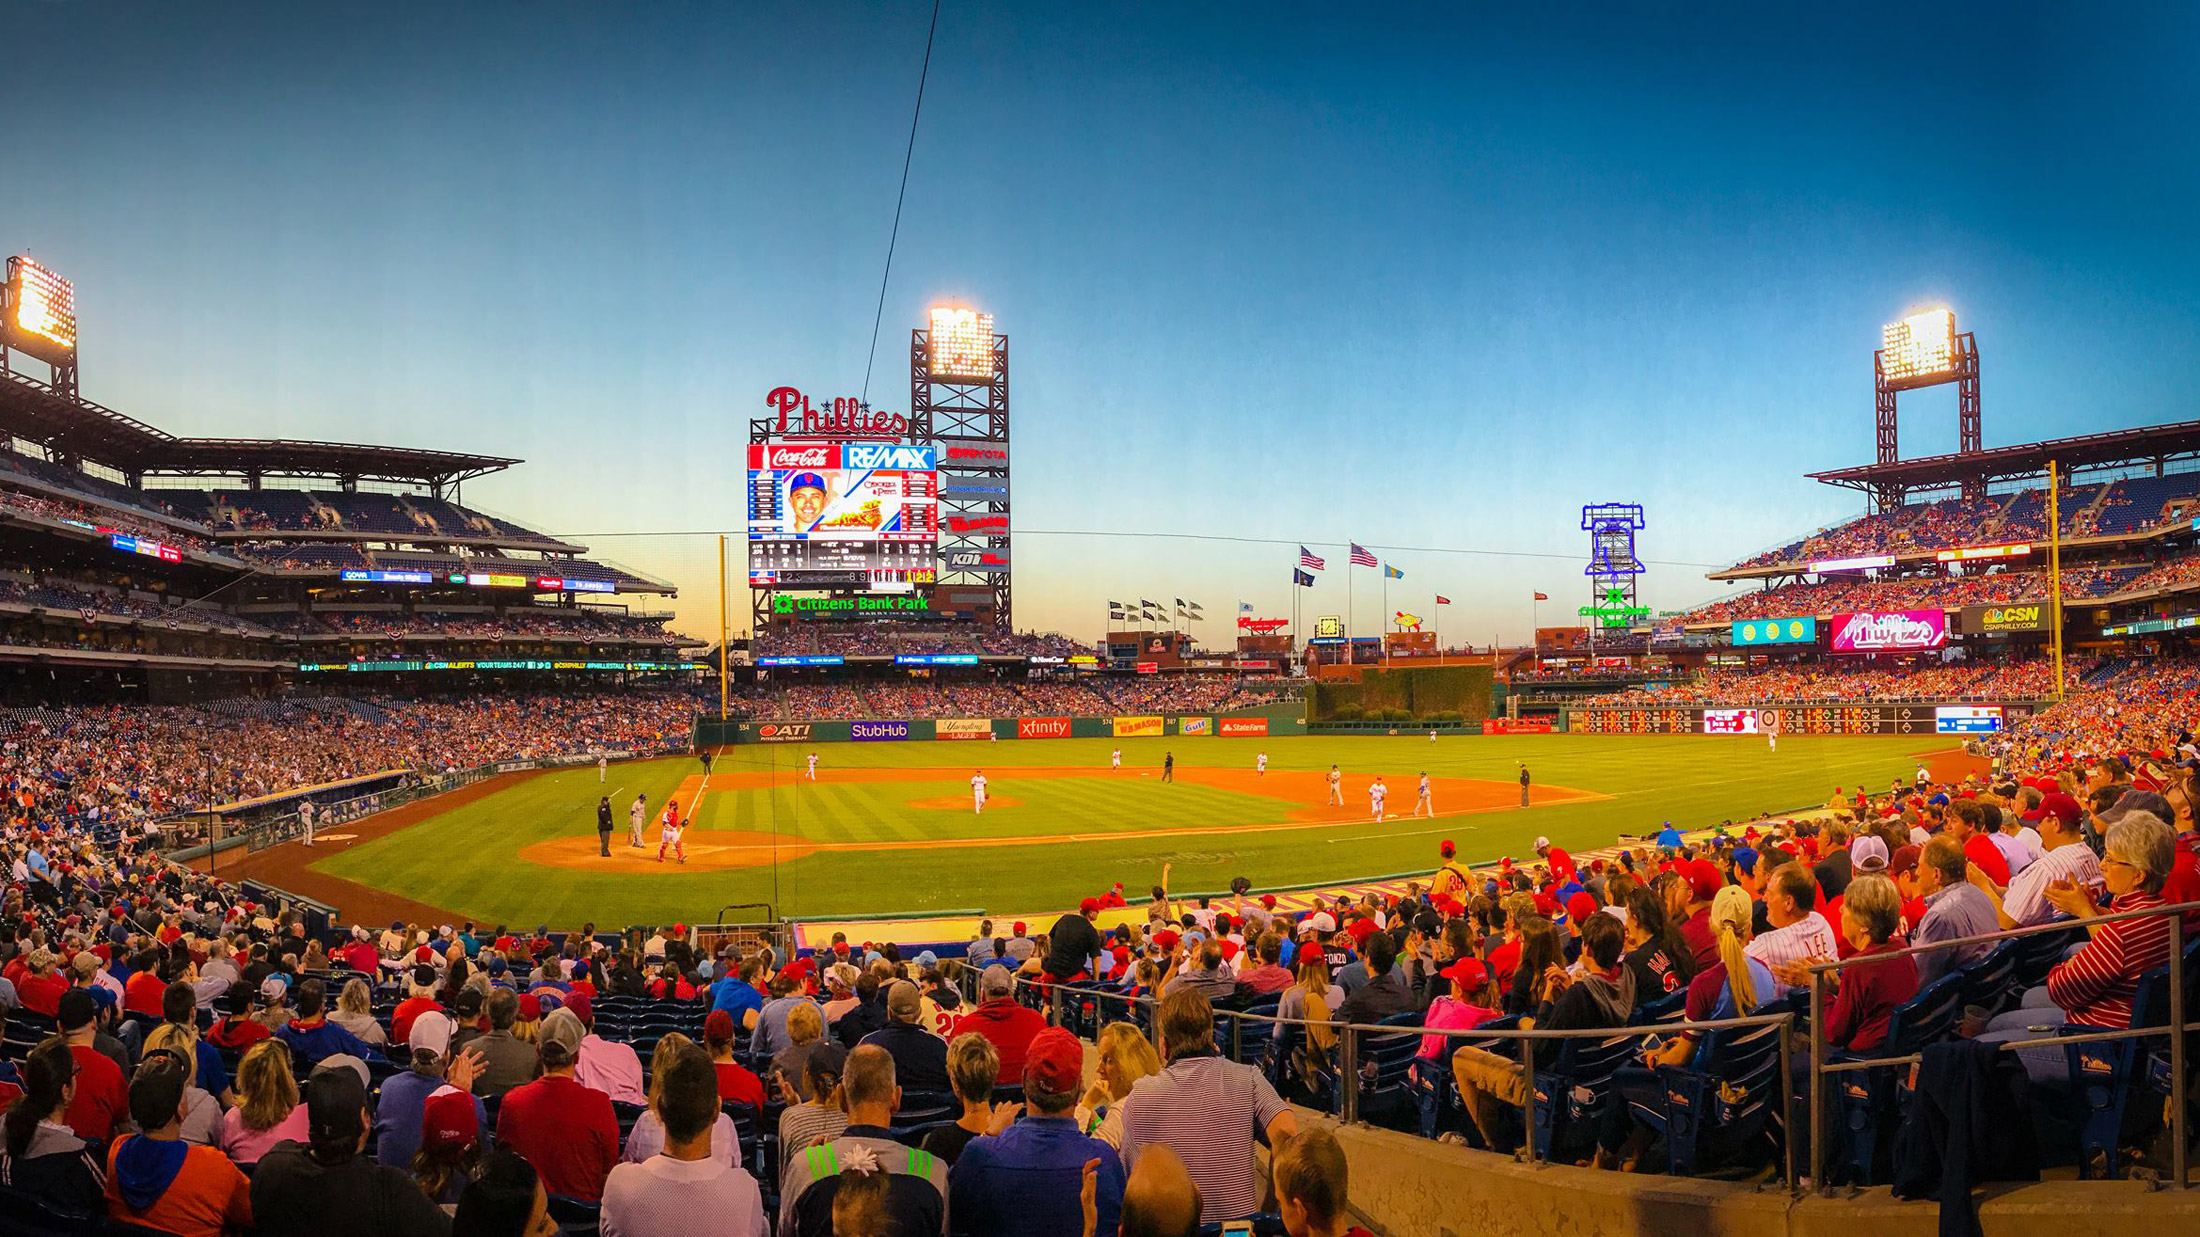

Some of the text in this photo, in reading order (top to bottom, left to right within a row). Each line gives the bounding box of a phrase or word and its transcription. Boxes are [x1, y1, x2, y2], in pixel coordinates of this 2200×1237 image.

[766, 386, 908, 433] Phillies
[772, 448, 830, 467] Coca-Cola
[848, 446, 929, 469] RE/MAX
[906, 572, 912, 583] 1
[916, 572, 923, 583] 2
[926, 572, 933, 583] 2
[797, 596, 928, 610] Citizens Bank Park
[2003, 606, 2039, 622] CSN
[1852, 613, 1934, 648] Phillies
[1983, 622, 2038, 631] CSNPHILLY.COM
[777, 725, 811, 735] ATI
[852, 725, 907, 737] StubHub
[1022, 720, 1067, 736] xfinity
[1185, 721, 1205, 732] Gulf
[1804, 933, 1828, 959] LEE
[1323, 953, 1347, 965] FONZO
